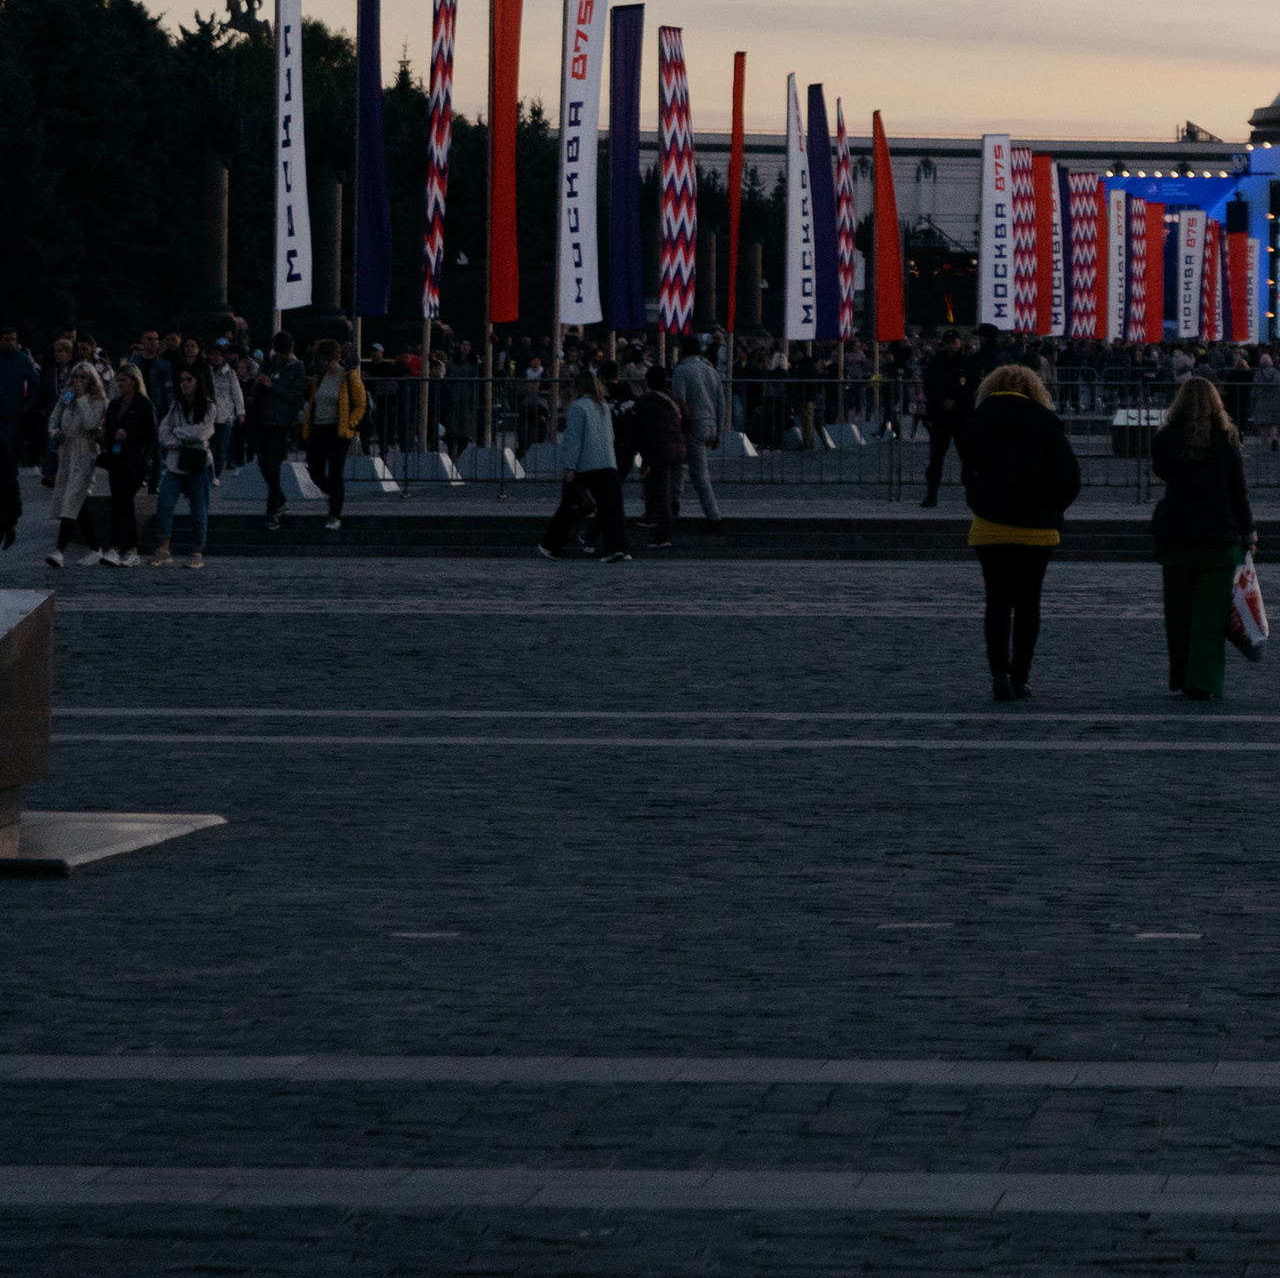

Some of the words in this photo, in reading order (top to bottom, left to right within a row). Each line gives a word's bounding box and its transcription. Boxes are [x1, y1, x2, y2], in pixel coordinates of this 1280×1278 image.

[571, 0, 595, 81] 875
[566, 101, 584, 304] МОСКВА
[993, 144, 1006, 192] 875
[993, 203, 1008, 319] МОСКВА
[1186, 217, 1198, 248] 875
[1183, 255, 1195, 331] МОСКВА
